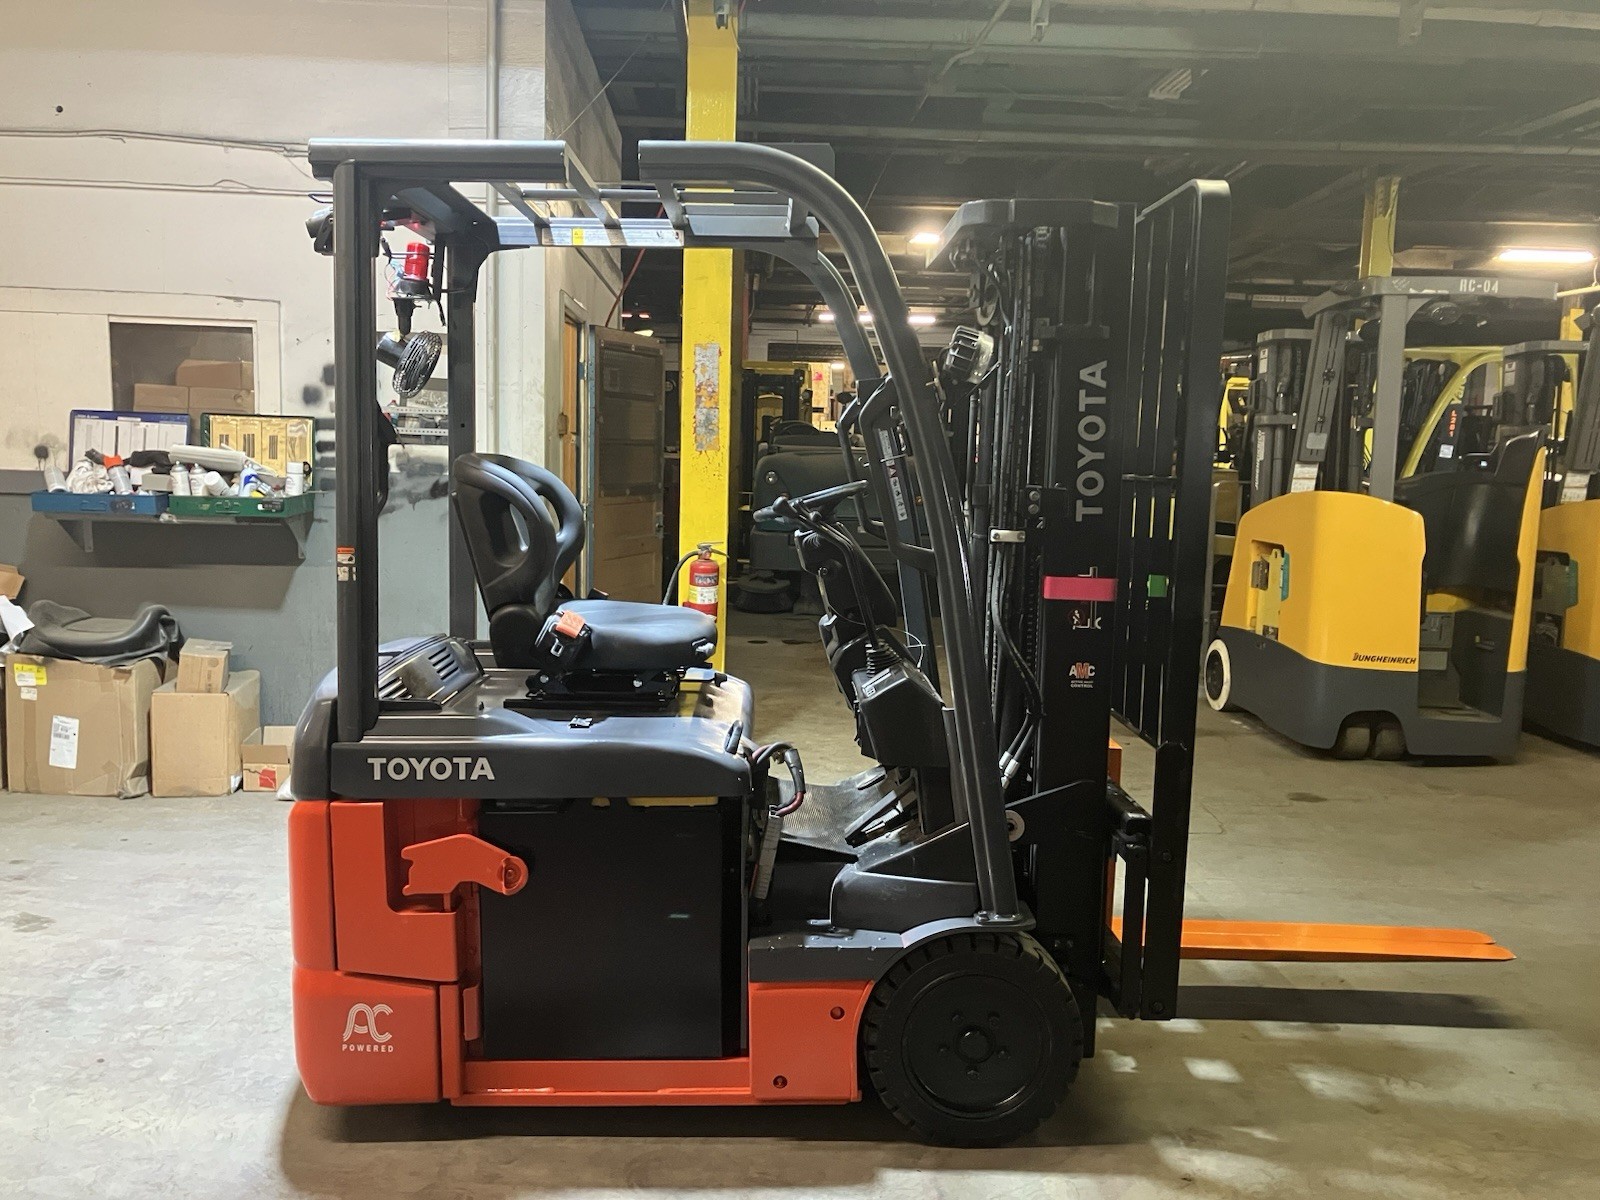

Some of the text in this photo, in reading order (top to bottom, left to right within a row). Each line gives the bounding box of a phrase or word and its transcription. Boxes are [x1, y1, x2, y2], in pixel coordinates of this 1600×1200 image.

[1075, 360, 1108, 523] TOYOTA
[1353, 652, 1417, 664] JUNGHEINRICH
[1068, 662, 1096, 679] AMC
[367, 757, 495, 780] TOYOTA
[342, 1003, 394, 1043] AC
[341, 1044, 394, 1052] POWERED
